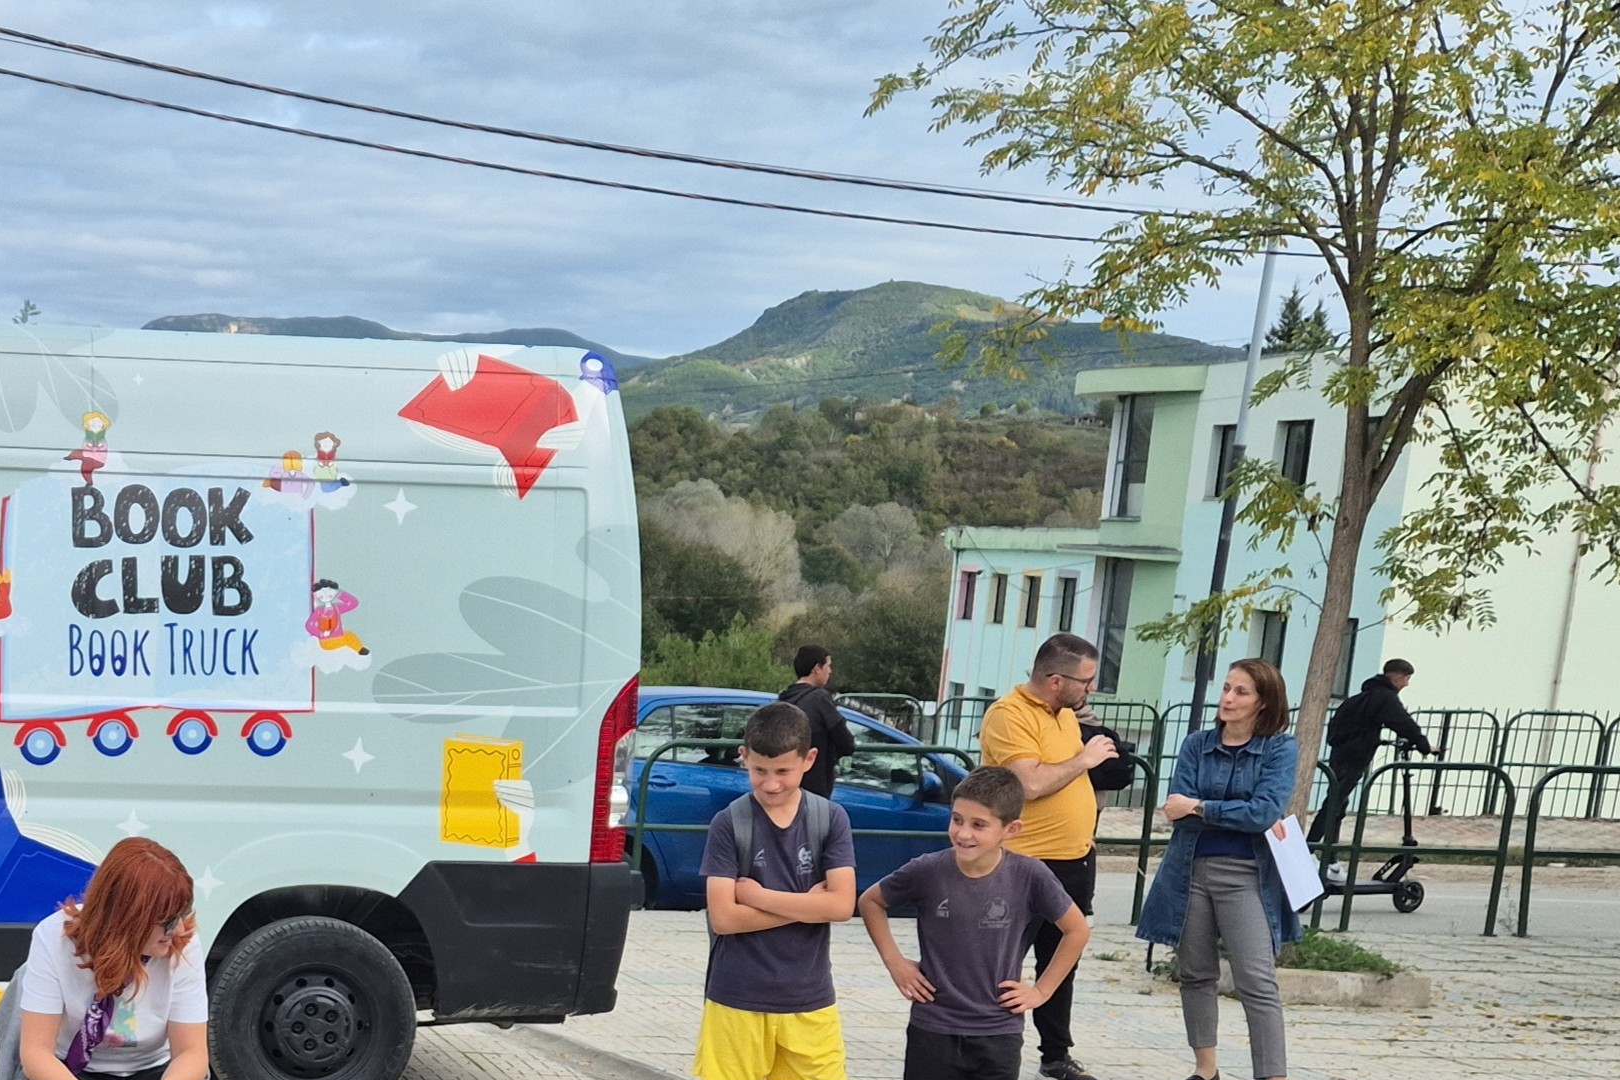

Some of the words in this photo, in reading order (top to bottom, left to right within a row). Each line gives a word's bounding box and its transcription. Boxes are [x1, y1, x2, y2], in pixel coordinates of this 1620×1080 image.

[71, 484, 254, 548] BOOK
[71, 555, 253, 619] CLUB
[69, 623, 151, 677] BOOK
[164, 622, 260, 677] TRUCK
